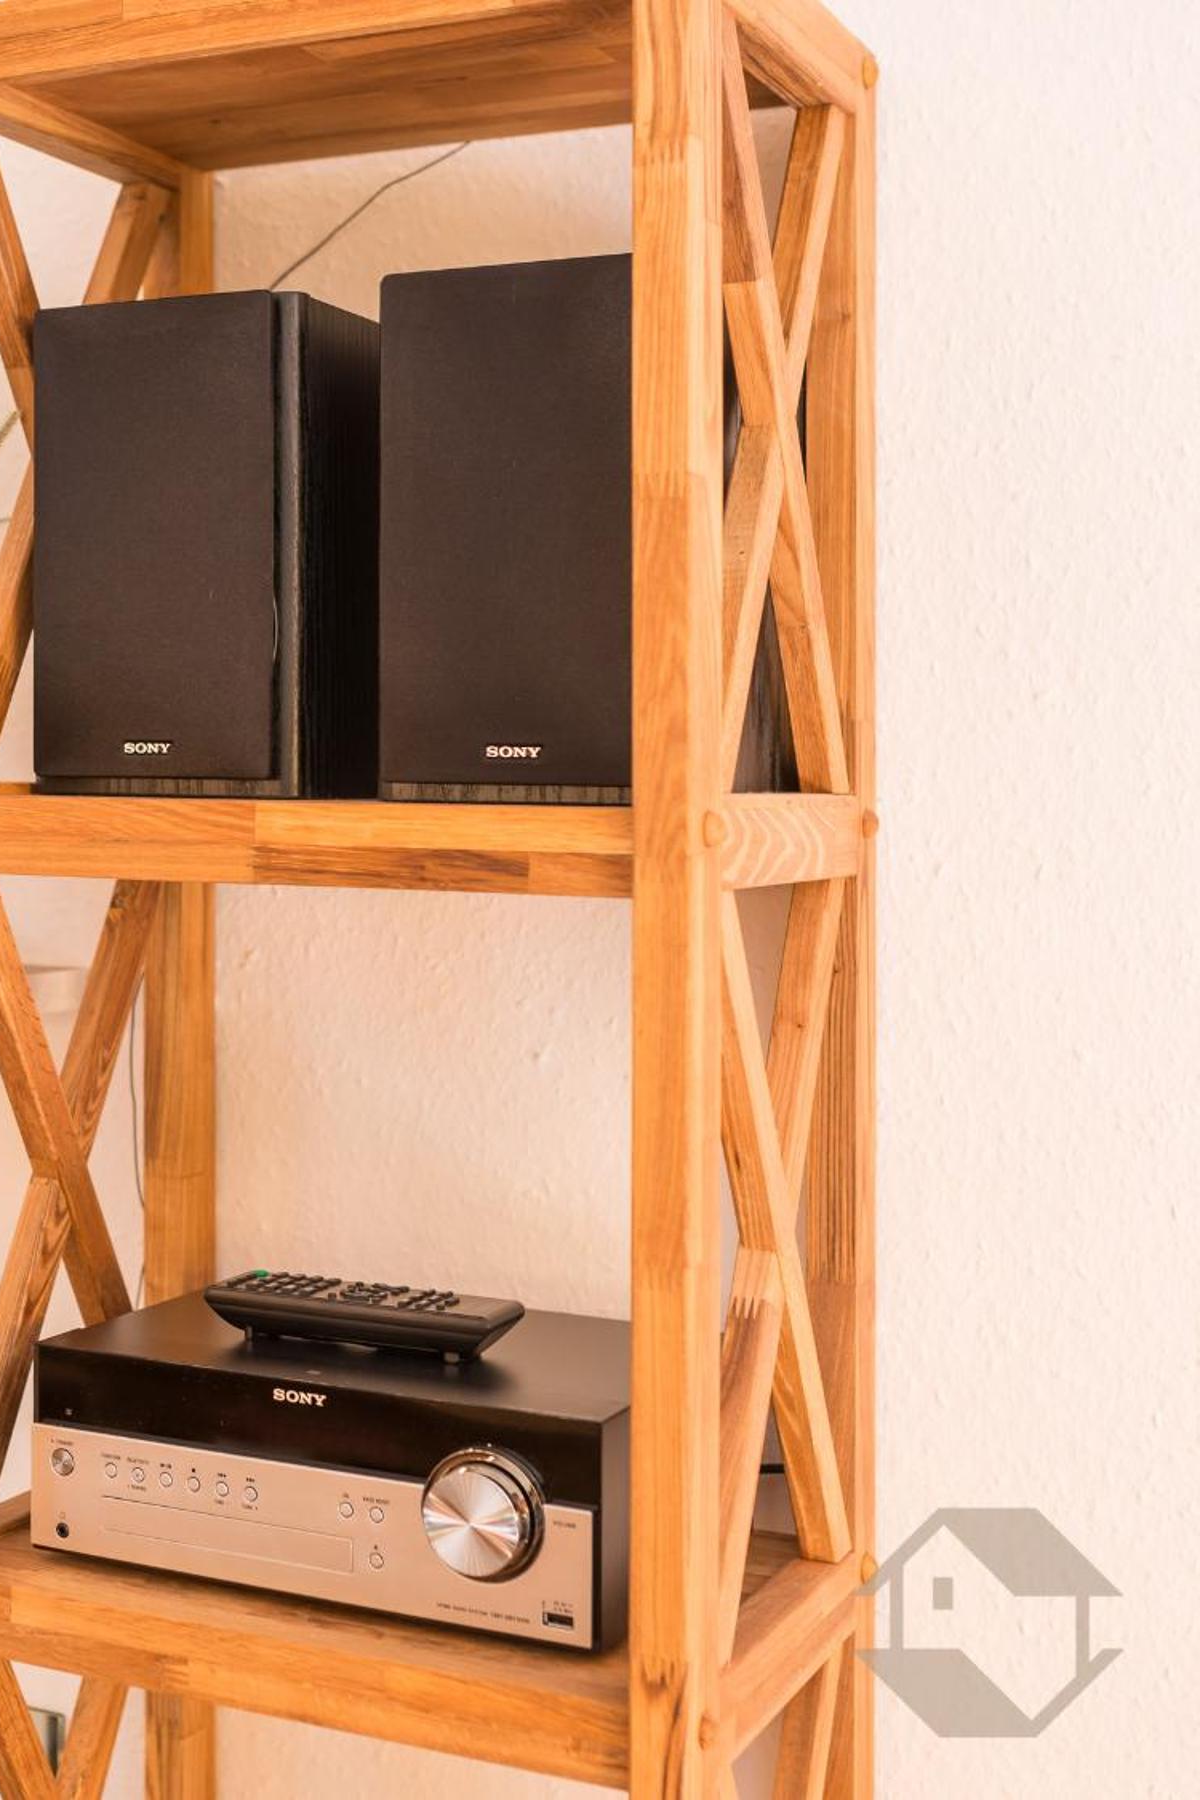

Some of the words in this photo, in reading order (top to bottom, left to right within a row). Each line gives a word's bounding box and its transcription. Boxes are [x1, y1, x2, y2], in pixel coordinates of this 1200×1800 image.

[123, 742, 171, 754] SONY
[485, 745, 541, 758] SONY
[272, 1387, 327, 1407] SONY
